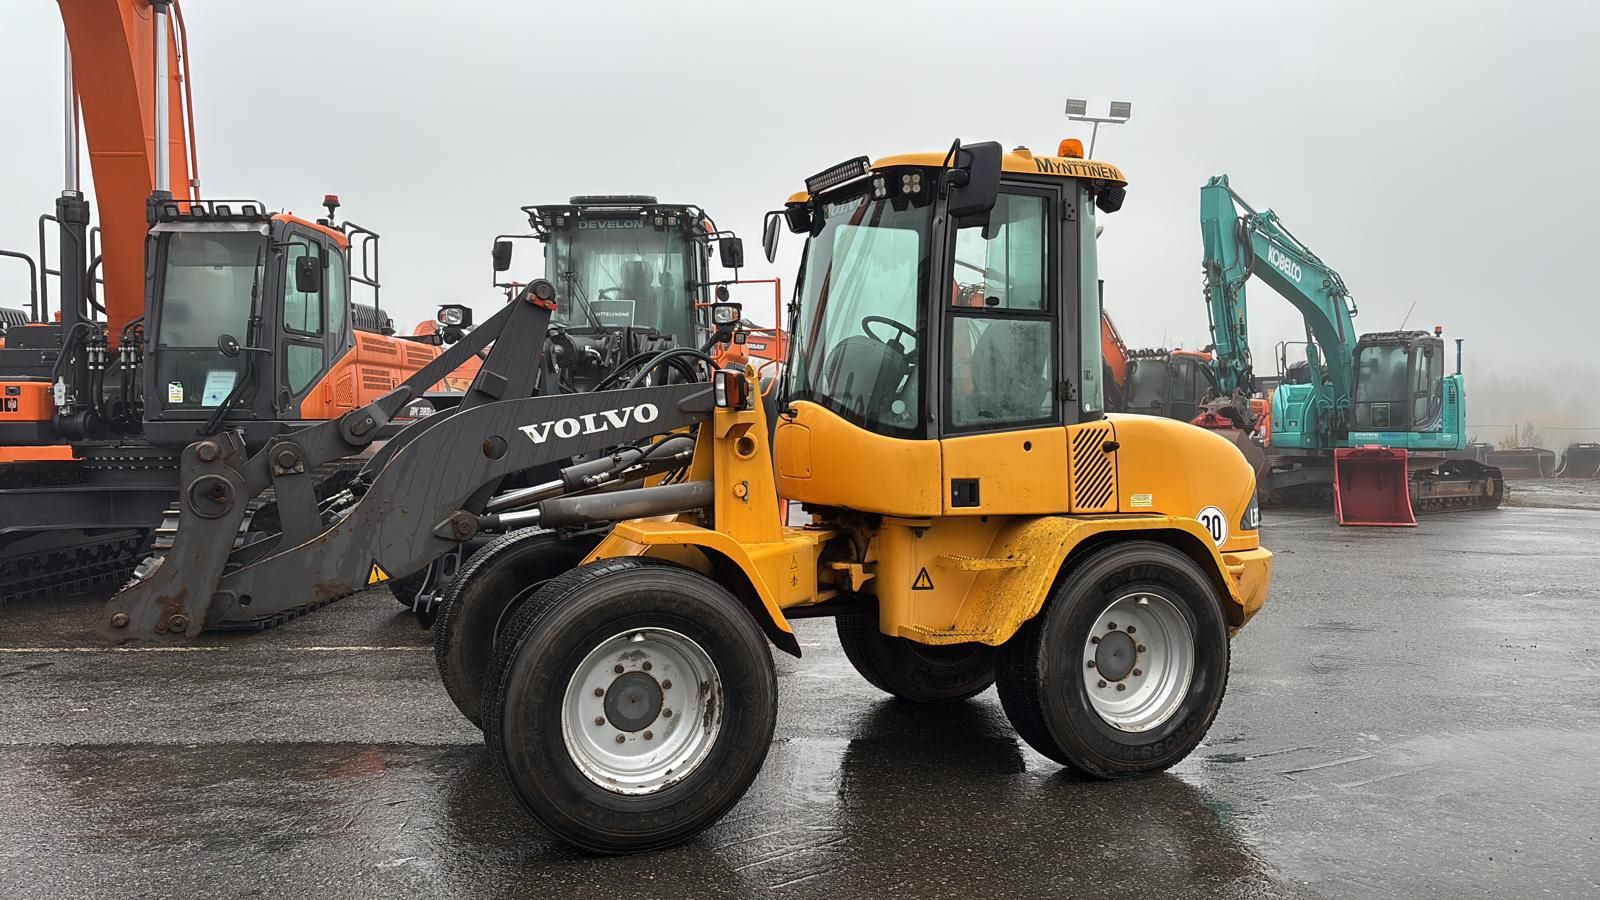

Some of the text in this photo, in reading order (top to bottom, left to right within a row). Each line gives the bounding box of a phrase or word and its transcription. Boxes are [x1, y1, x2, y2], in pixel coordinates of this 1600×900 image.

[1034, 157, 1118, 179] MYNTTINEN
[578, 220, 643, 229] DEVELON
[1267, 244, 1302, 283] KOBELCO
[518, 403, 659, 444] VOLVO
